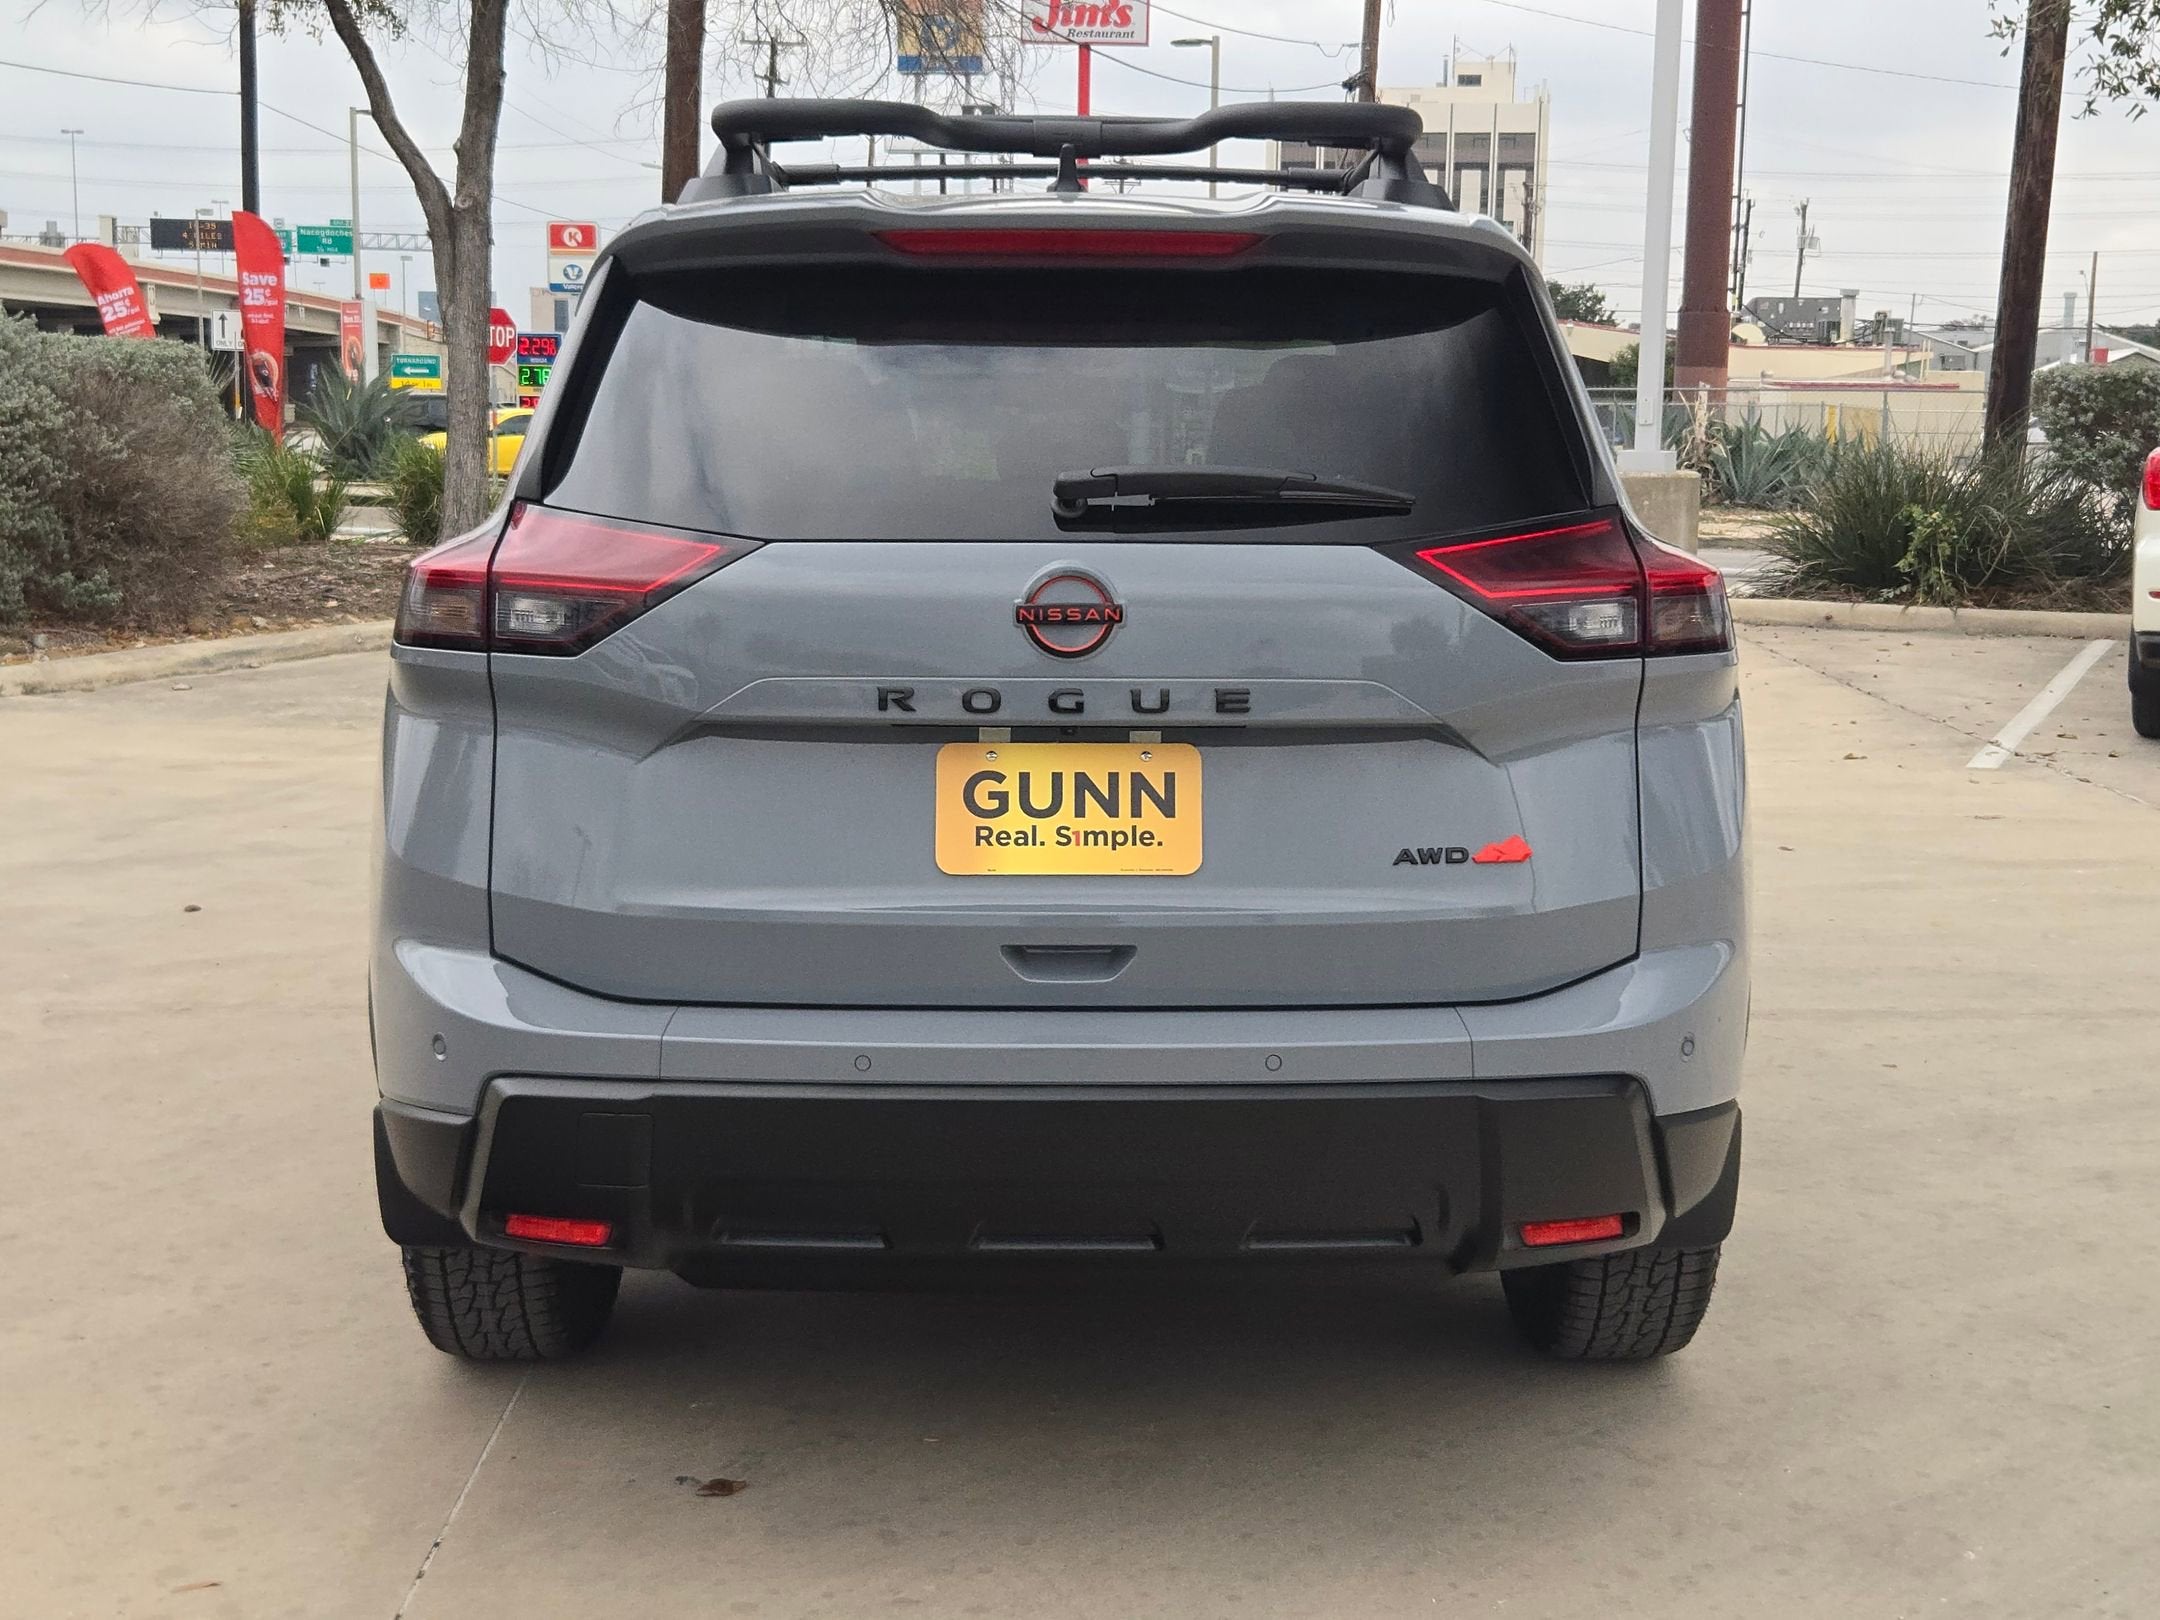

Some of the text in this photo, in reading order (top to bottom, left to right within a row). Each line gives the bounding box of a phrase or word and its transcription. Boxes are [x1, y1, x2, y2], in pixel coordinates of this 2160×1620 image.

[1031, 0, 1133, 34] Jim's
[1067, 28, 1134, 39] Restaurant
[242, 272, 278, 286] Save
[97, 287, 135, 305] Ahorra
[489, 326, 515, 348] TOP
[1018, 607, 1121, 622] NISSAN
[877, 686, 1251, 714] ROGUE
[962, 771, 1177, 820] GUNN
[975, 826, 1046, 847] Real.
[1393, 847, 1470, 866] AWD
